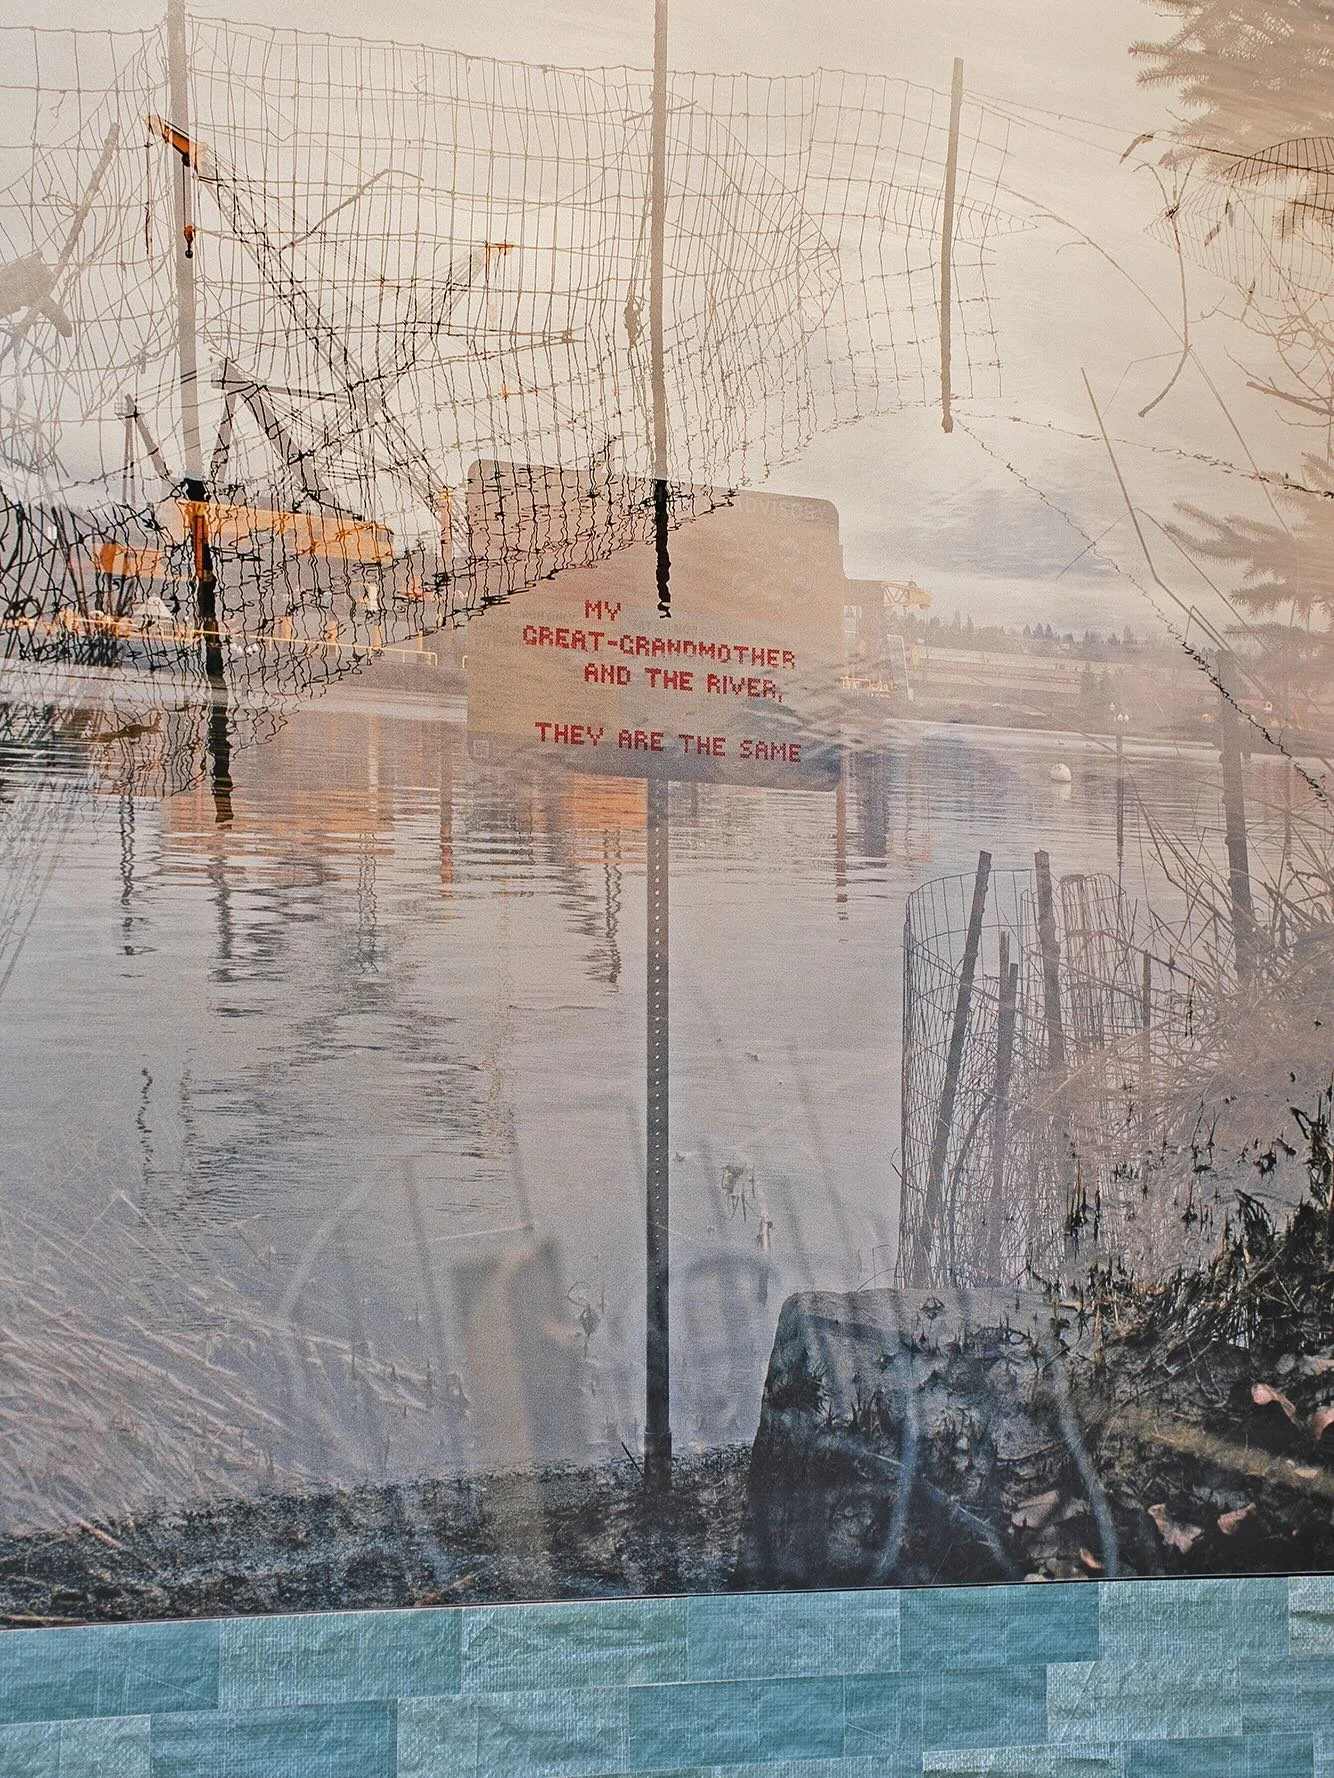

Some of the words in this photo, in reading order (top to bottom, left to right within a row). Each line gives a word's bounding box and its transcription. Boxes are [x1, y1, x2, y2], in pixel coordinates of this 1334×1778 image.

[584, 600, 622, 622] MY
[522, 624, 796, 669] GREAT-GRANDMOTHER
[583, 662, 631, 686] AND
[644, 668, 694, 692] THE
[707, 673, 783, 703] RIVER,
[535, 721, 604, 746] THEY
[618, 729, 665, 753] ARE
[678, 734, 725, 758] THE
[740, 739, 802, 763] SAME
